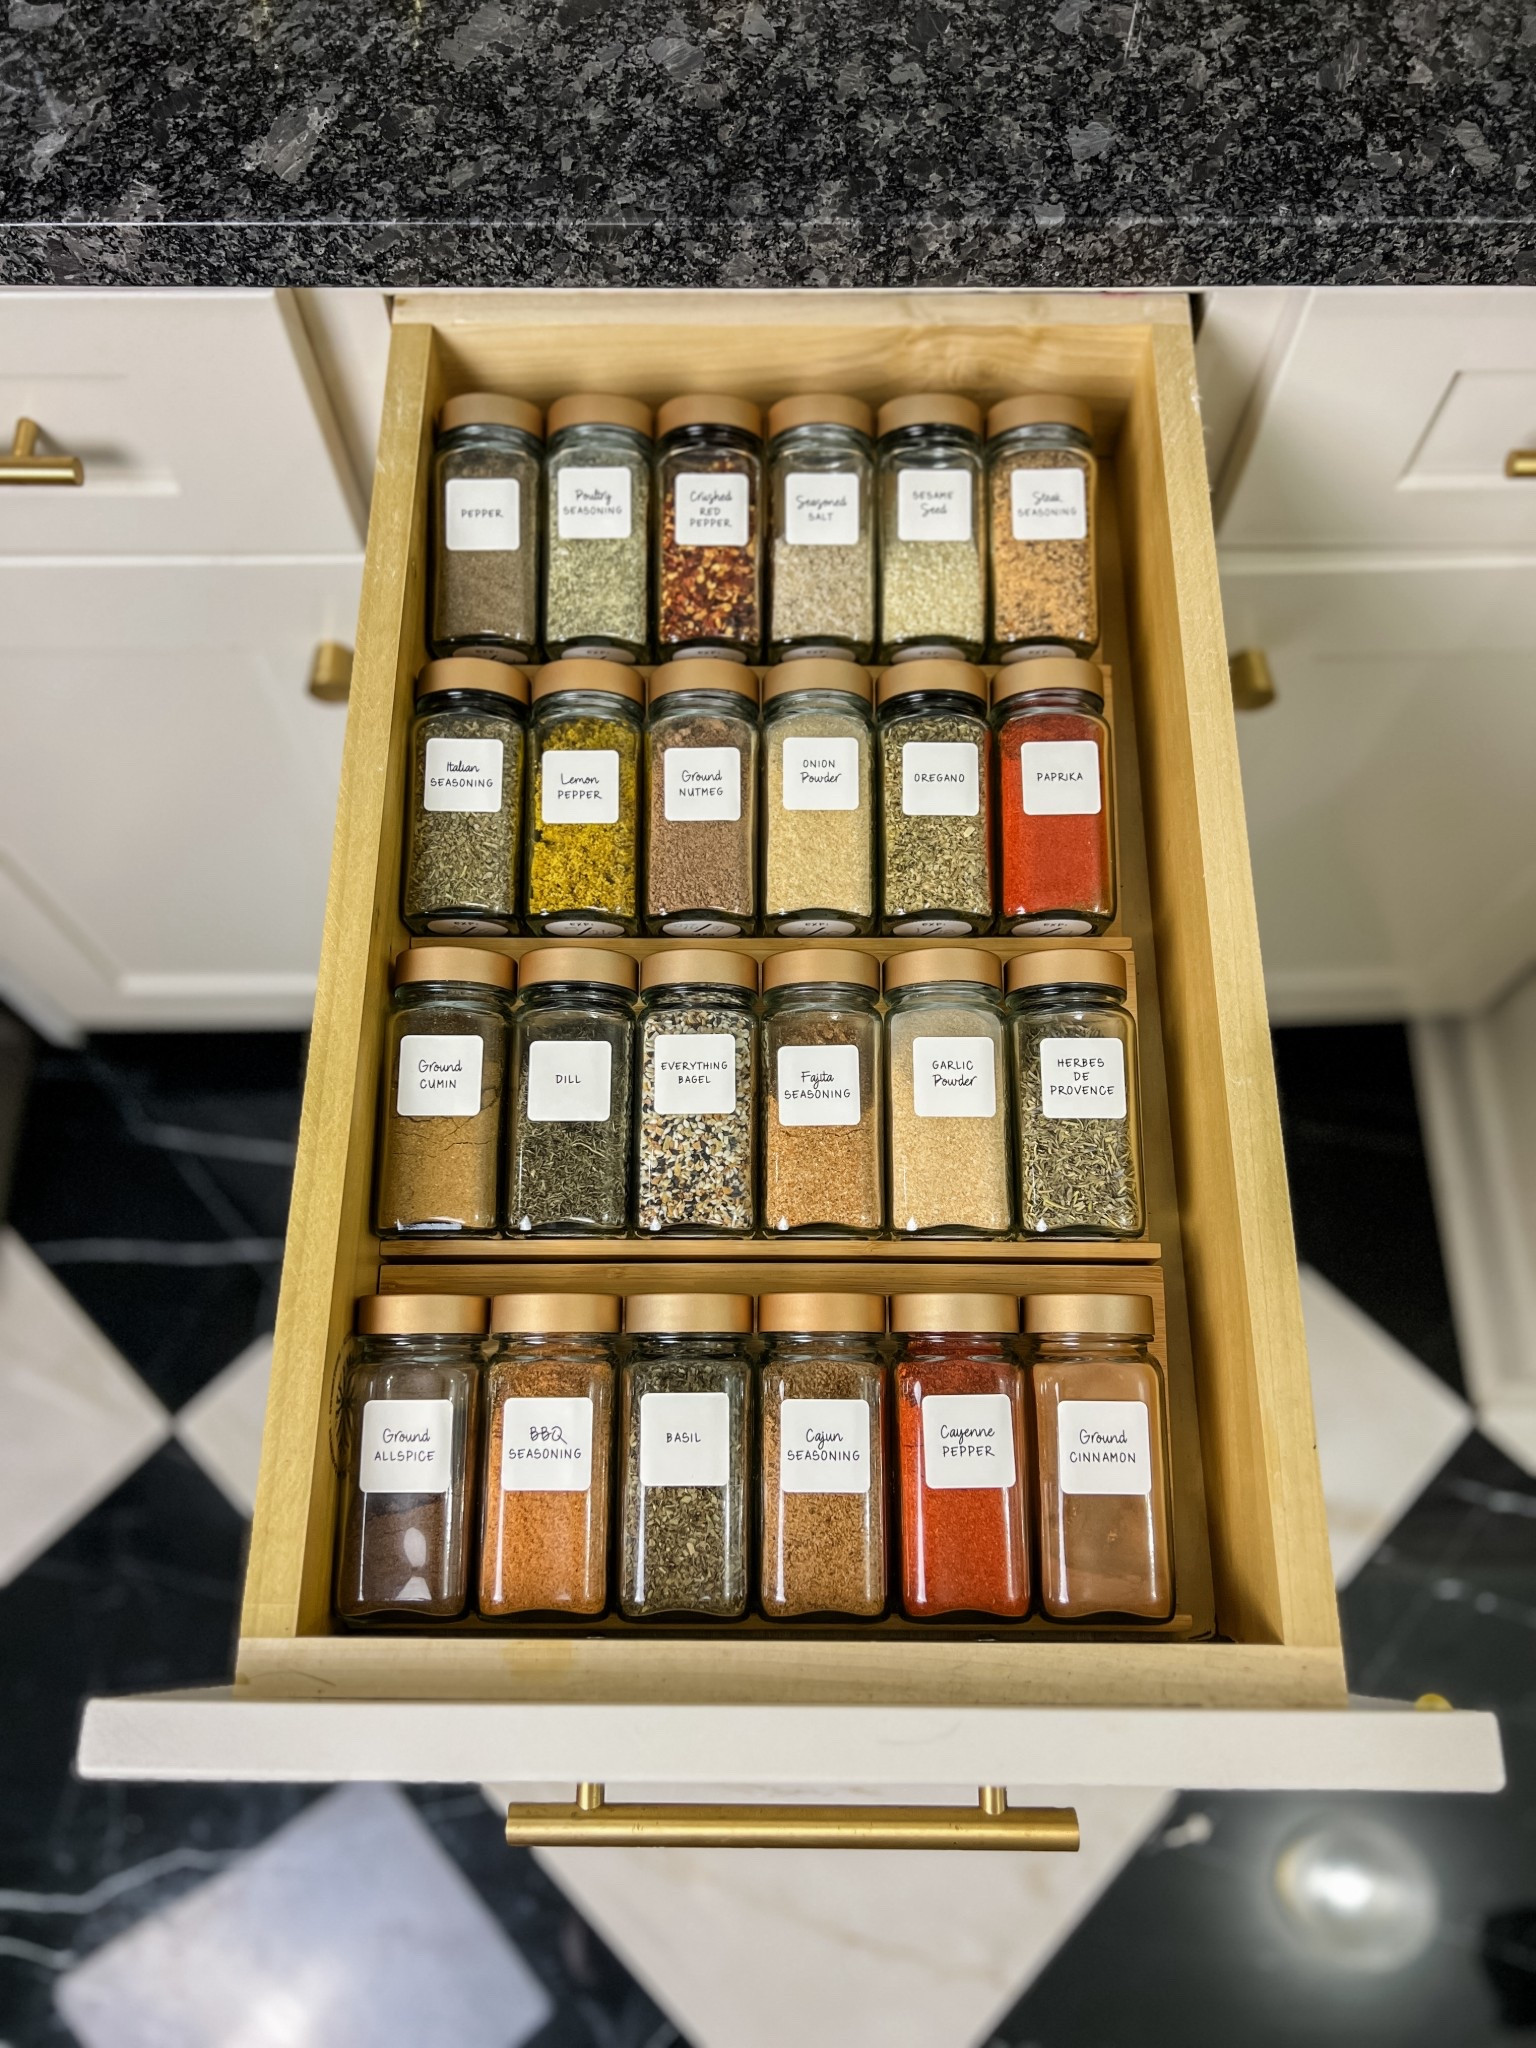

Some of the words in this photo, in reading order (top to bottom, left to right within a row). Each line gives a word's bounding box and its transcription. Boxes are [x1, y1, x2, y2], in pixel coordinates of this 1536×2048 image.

[575, 489, 612, 507] Poultry
[689, 490, 732, 505] Crushed
[912, 491, 954, 501] SESAME
[795, 494, 848, 512] Seasoned
[461, 508, 505, 519] PEPPER
[563, 506, 623, 516] SEASONING
[700, 507, 721, 516] RED
[808, 512, 834, 522] SALT
[1017, 506, 1078, 517] SEASONING
[690, 518, 732, 528] PEPPER
[446, 760, 480, 774] Italian
[802, 759, 836, 769] ONION
[560, 773, 600, 785] Lemon
[681, 769, 723, 783] Ground
[800, 771, 842, 784] Powder
[914, 773, 966, 783] OREGANO
[1036, 772, 1084, 782] PAPRIKA
[430, 777, 494, 788] SEASONING
[557, 789, 603, 801] PEPPER
[679, 787, 724, 797] NUTMEG
[418, 1060, 463, 1074] Ground
[660, 1061, 729, 1071] EVERYTHING
[931, 1060, 975, 1071] GARLIC
[1057, 1058, 1105, 1068] HERBES
[555, 1074, 582, 1084] DILL
[678, 1074, 712, 1084] BAGEL
[800, 1070, 835, 1089] Fajita
[932, 1072, 978, 1087] Powder
[1073, 1071, 1090, 1082] DE
[419, 1078, 457, 1090] CUMIN
[784, 1088, 851, 1100] SEASONING
[1050, 1085, 1115, 1096] PROVENCE
[382, 1427, 431, 1444] Ground
[529, 1426, 569, 1445] BBQ
[666, 1432, 702, 1444] BASIL
[805, 1428, 844, 1452] Cajun
[940, 1424, 996, 1445] Cayenne
[1079, 1428, 1128, 1445] Ground
[374, 1450, 436, 1462] ALLSPICE
[508, 1448, 582, 1460] SEASONING
[787, 1449, 861, 1462] SEASONING
[942, 1445, 996, 1458] PEPPER
[1069, 1451, 1137, 1464] CINNAMON
